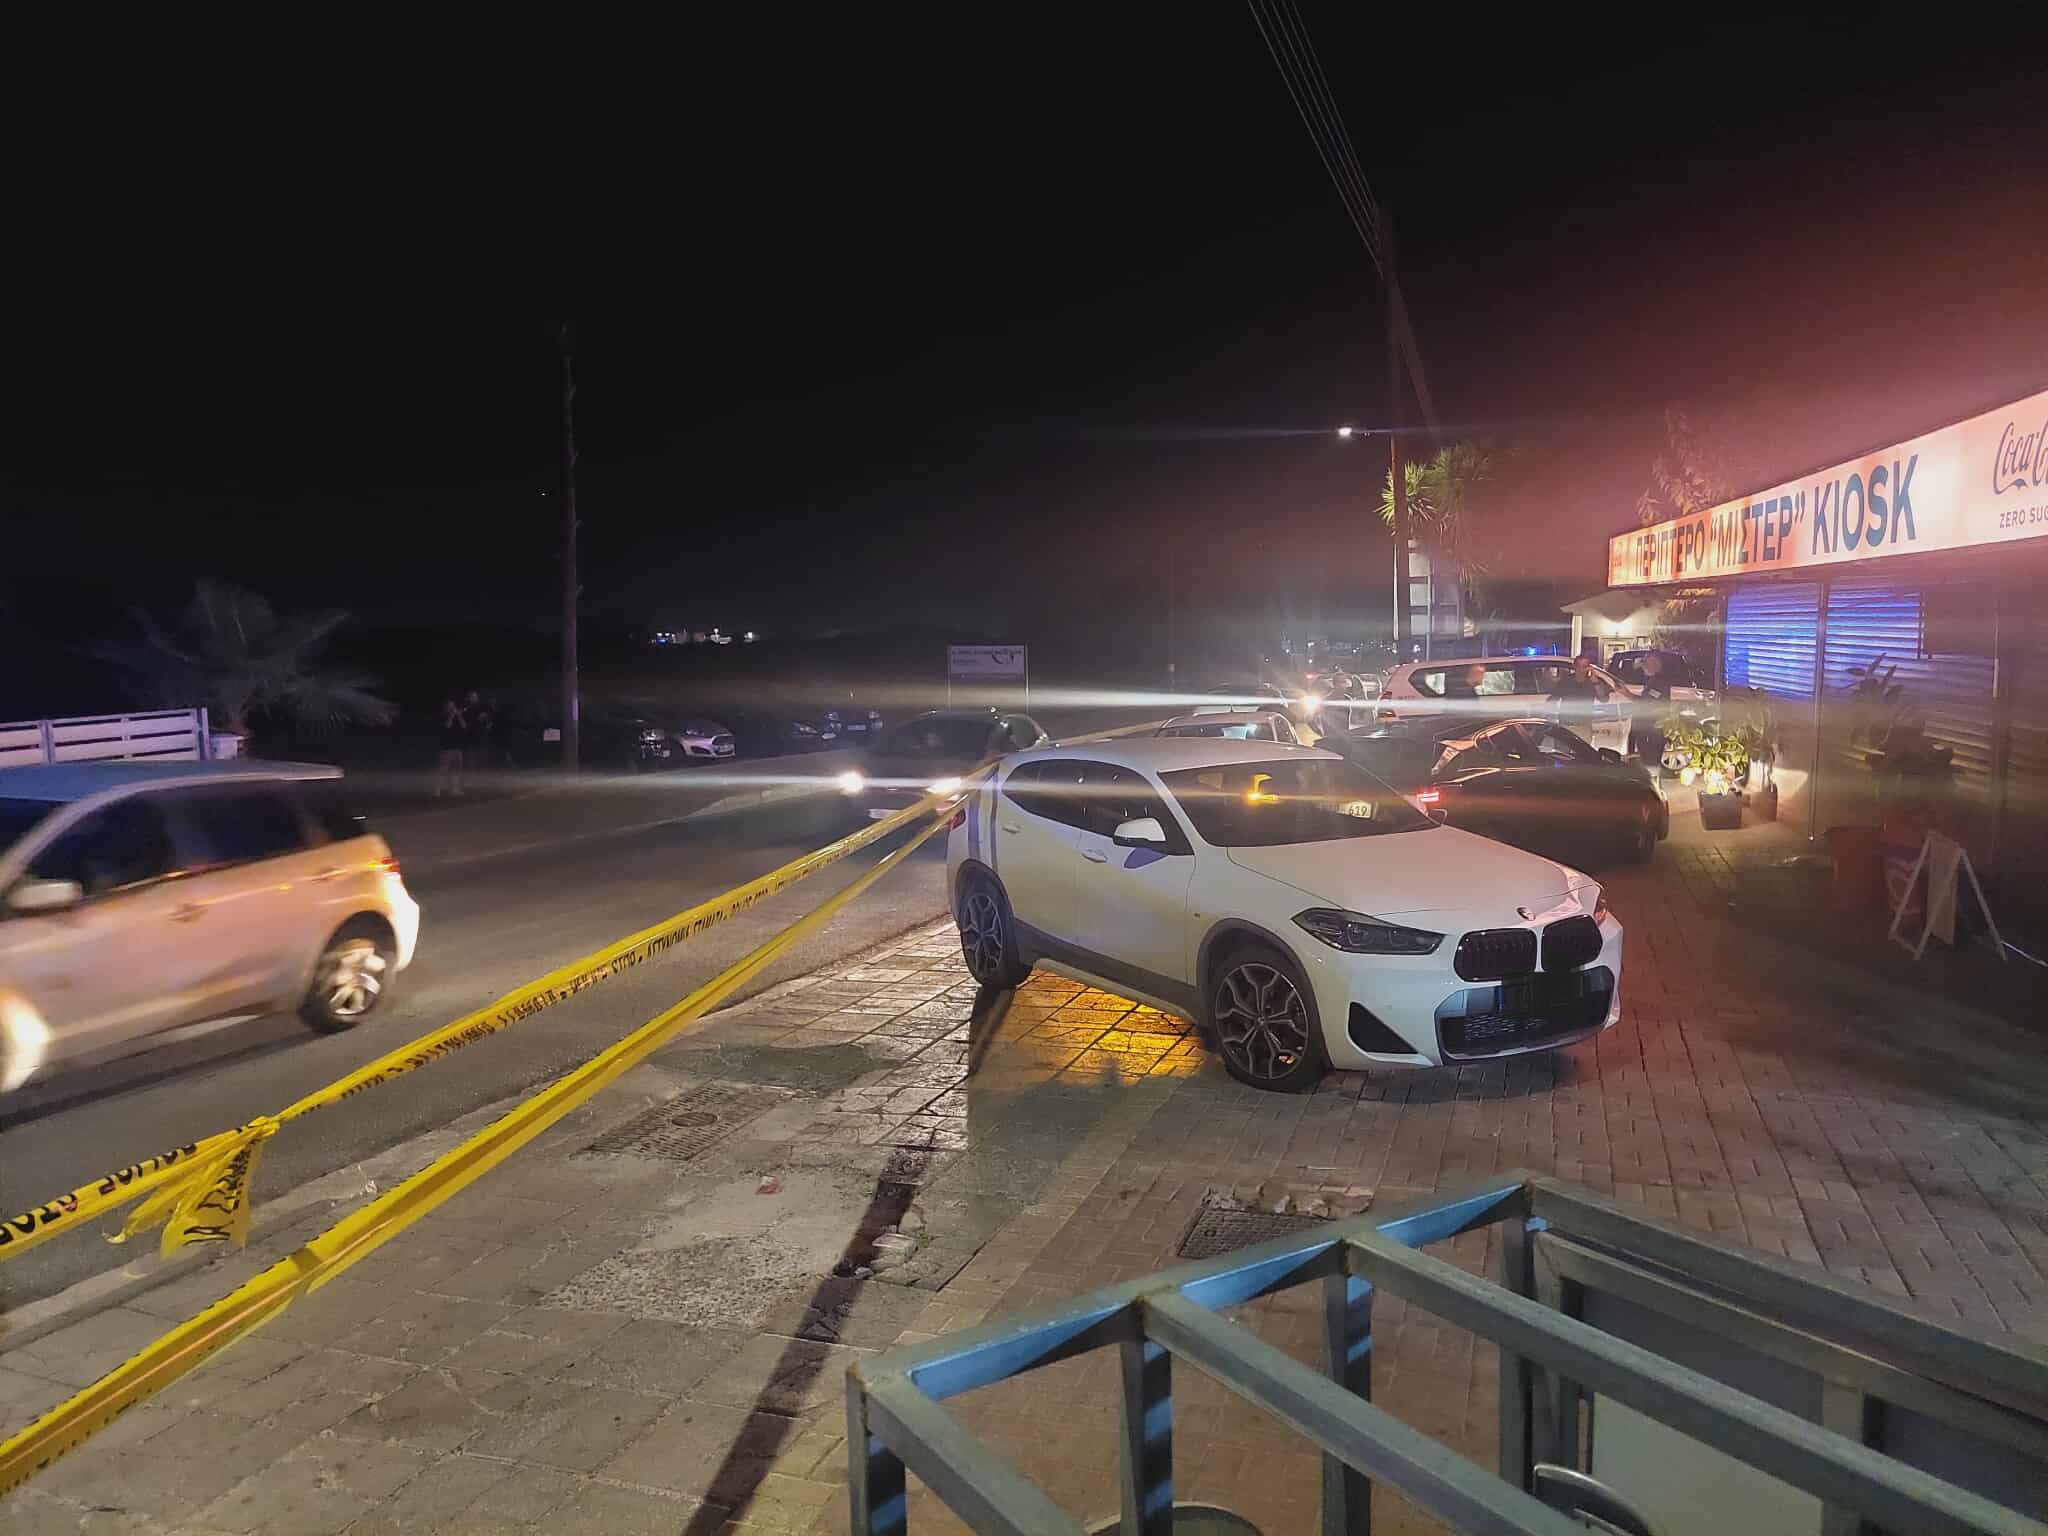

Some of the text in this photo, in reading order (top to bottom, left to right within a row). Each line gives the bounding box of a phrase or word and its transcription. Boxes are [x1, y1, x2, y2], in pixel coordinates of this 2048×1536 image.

[1811, 453, 1920, 555] KIOSK
[1999, 509, 2026, 529] ZERO
[1349, 804, 1368, 817] 619
